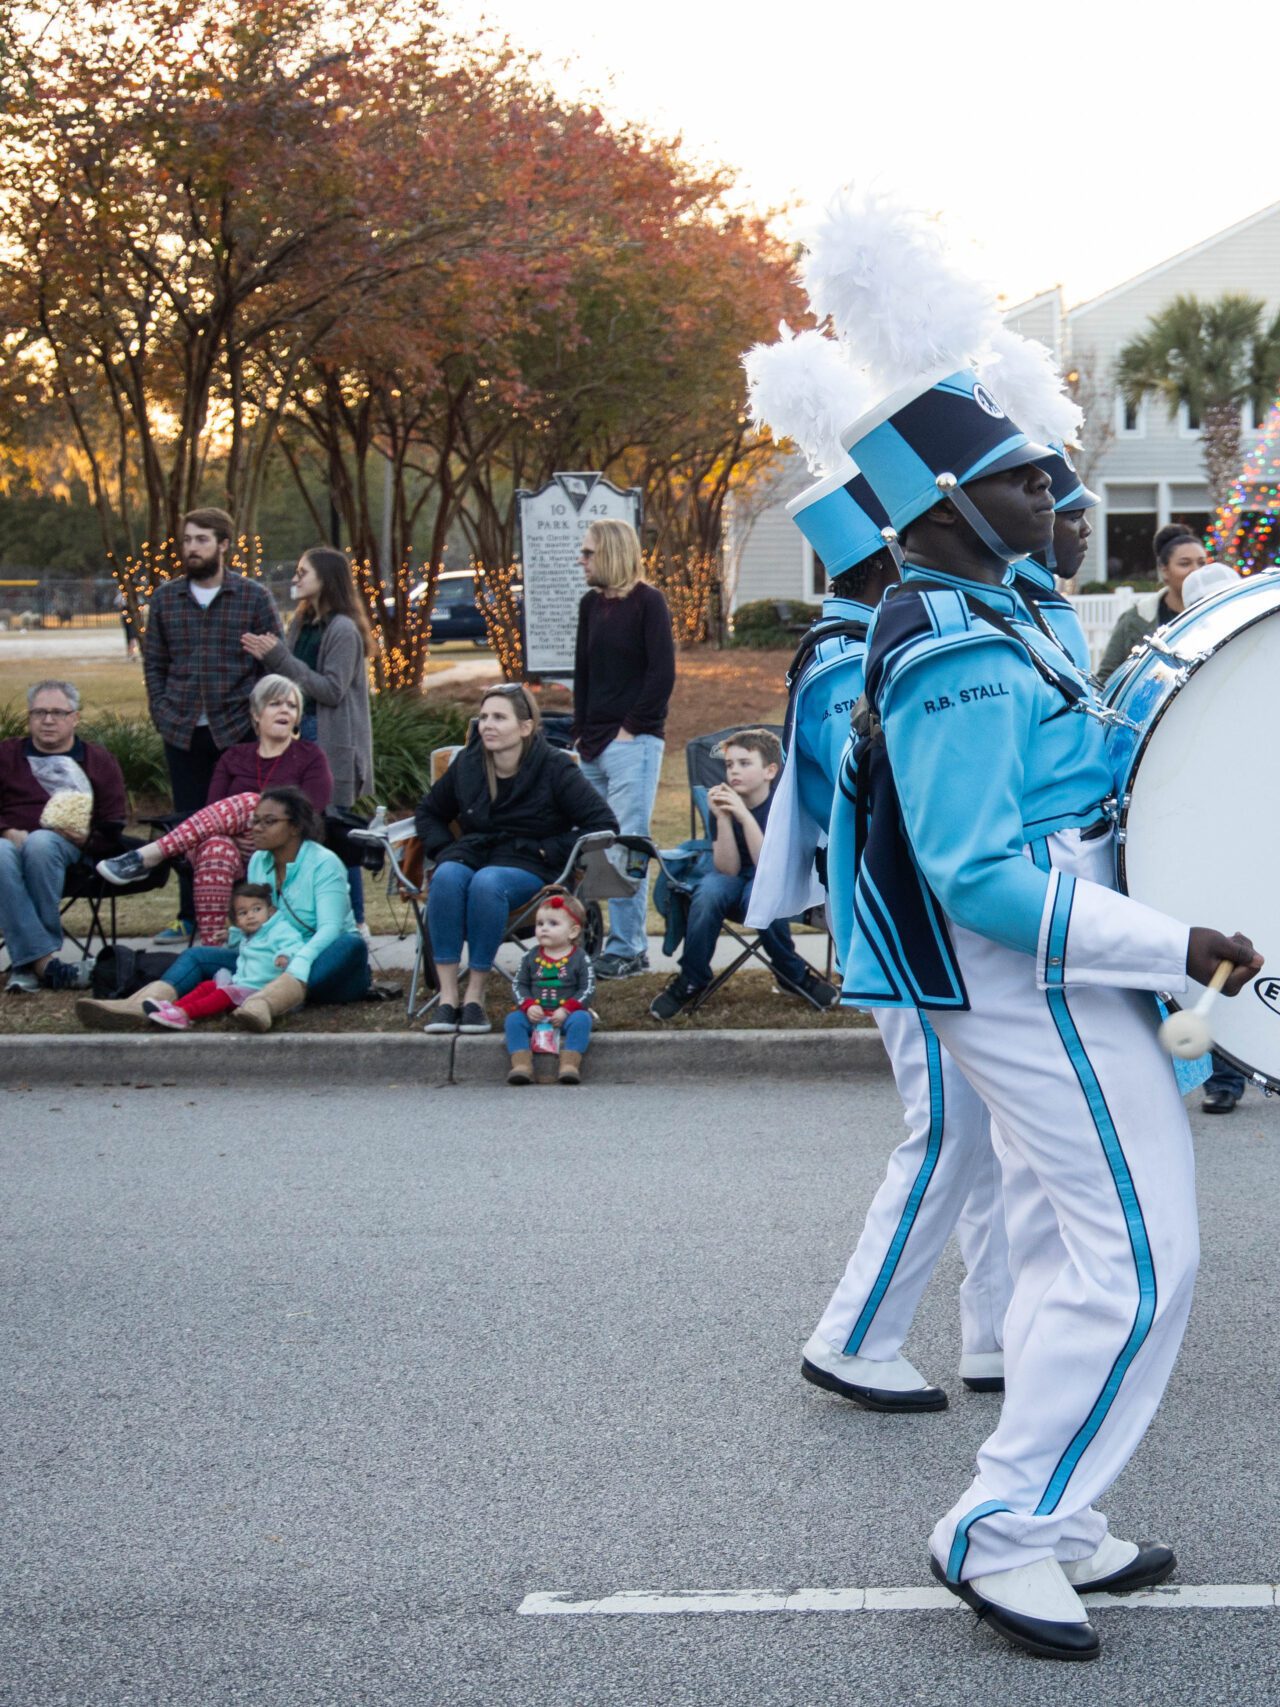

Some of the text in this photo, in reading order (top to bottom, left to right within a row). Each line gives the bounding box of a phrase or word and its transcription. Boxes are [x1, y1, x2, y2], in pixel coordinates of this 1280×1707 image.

[551, 504, 608, 516] 10 42
[537, 520, 570, 530] PARK
[924, 682, 1009, 715] R.B. STALL
